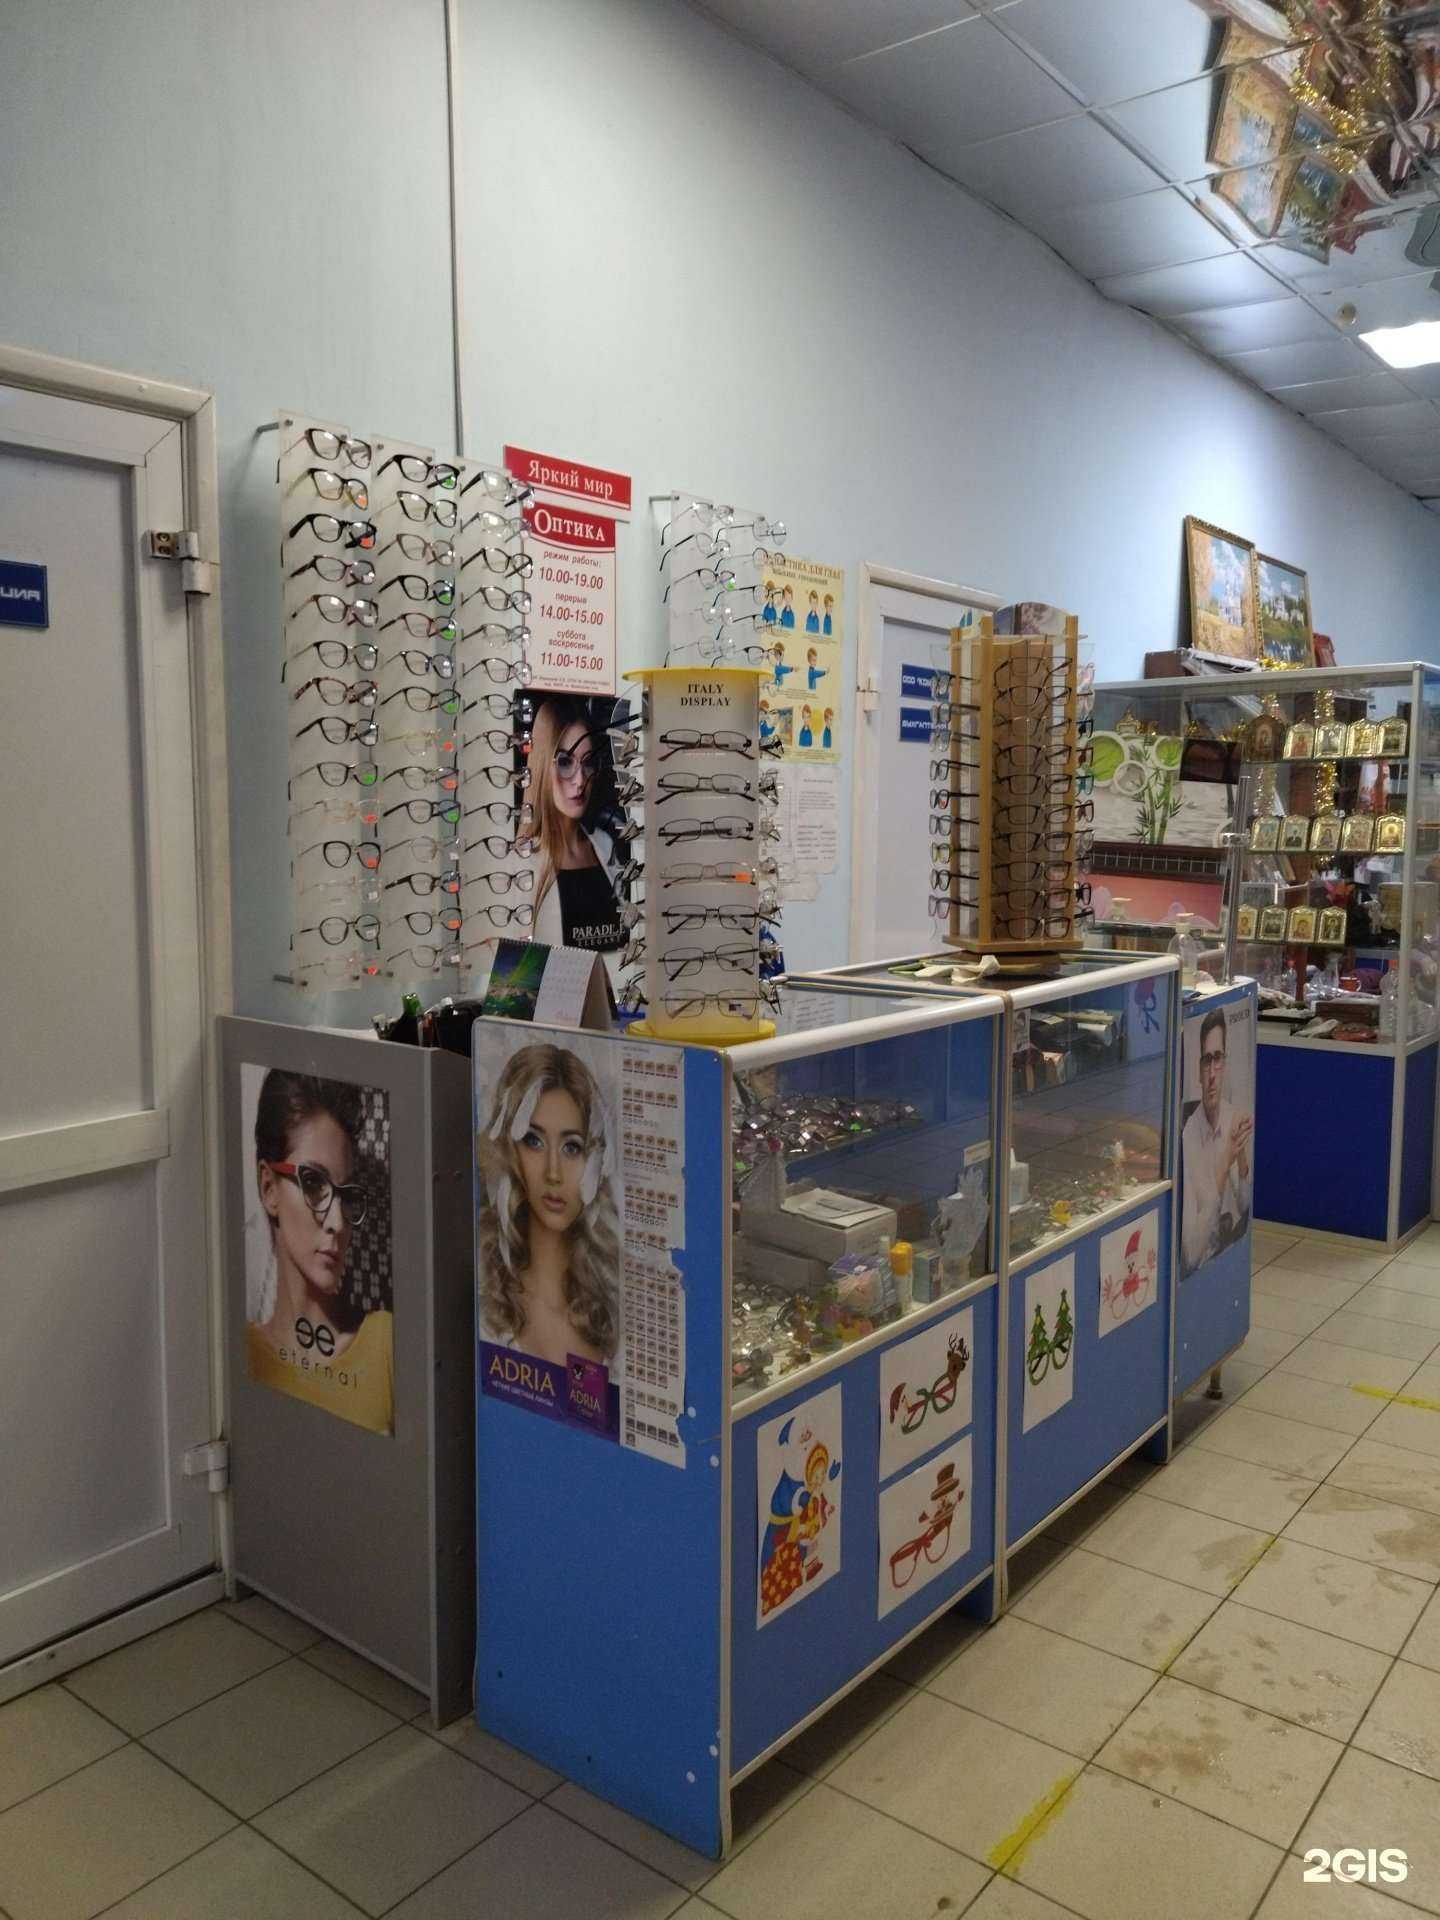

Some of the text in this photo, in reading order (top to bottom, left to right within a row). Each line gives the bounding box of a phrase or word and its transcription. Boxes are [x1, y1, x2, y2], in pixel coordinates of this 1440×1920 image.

[528, 460, 613, 500] Яркий мир
[543, 550, 570, 562] режим
[539, 566, 604, 590] 10.00-19.00
[555, 592, 587, 604] перерыв
[540, 605, 604, 625] 14.00-15.00
[548, 638, 595, 651] воскресенье
[556, 630, 586, 641] суббота
[540, 652, 604, 671] 11.00-15.00
[687, 683, 724, 694] ITALY
[680, 697, 731, 706] DISPLAY
[279, 1347, 358, 1389] eternal
[489, 1354, 557, 1398] ADRIA
[569, 1388, 602, 1413] ADRIA
